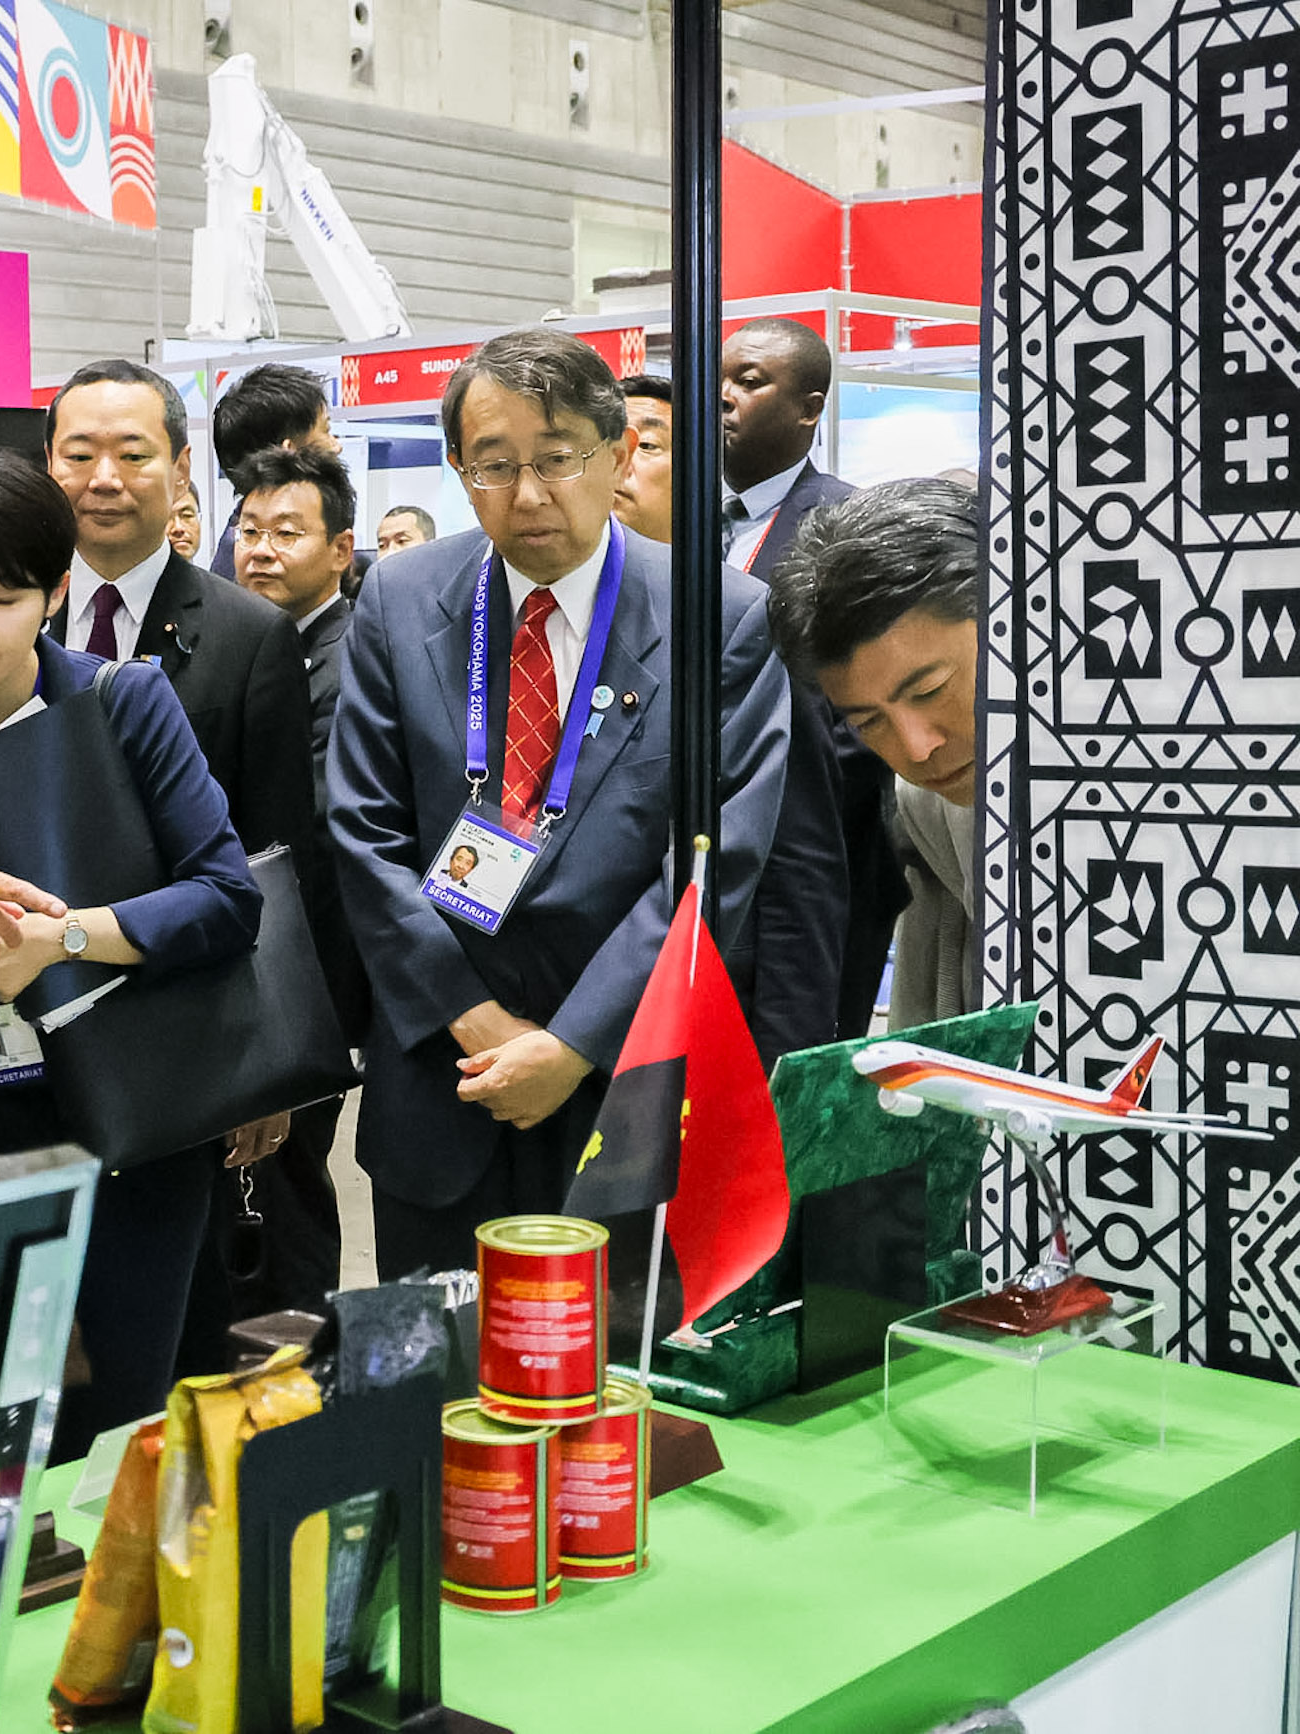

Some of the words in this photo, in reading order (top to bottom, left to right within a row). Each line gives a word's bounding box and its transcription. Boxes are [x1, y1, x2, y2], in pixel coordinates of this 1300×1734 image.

[374, 370, 398, 385] A45
[421, 357, 464, 374] SUNDA
[471, 614, 485, 692] YOKOHAMA
[470, 695, 483, 731] 2025
[428, 885, 493, 923] SECRETARIAT
